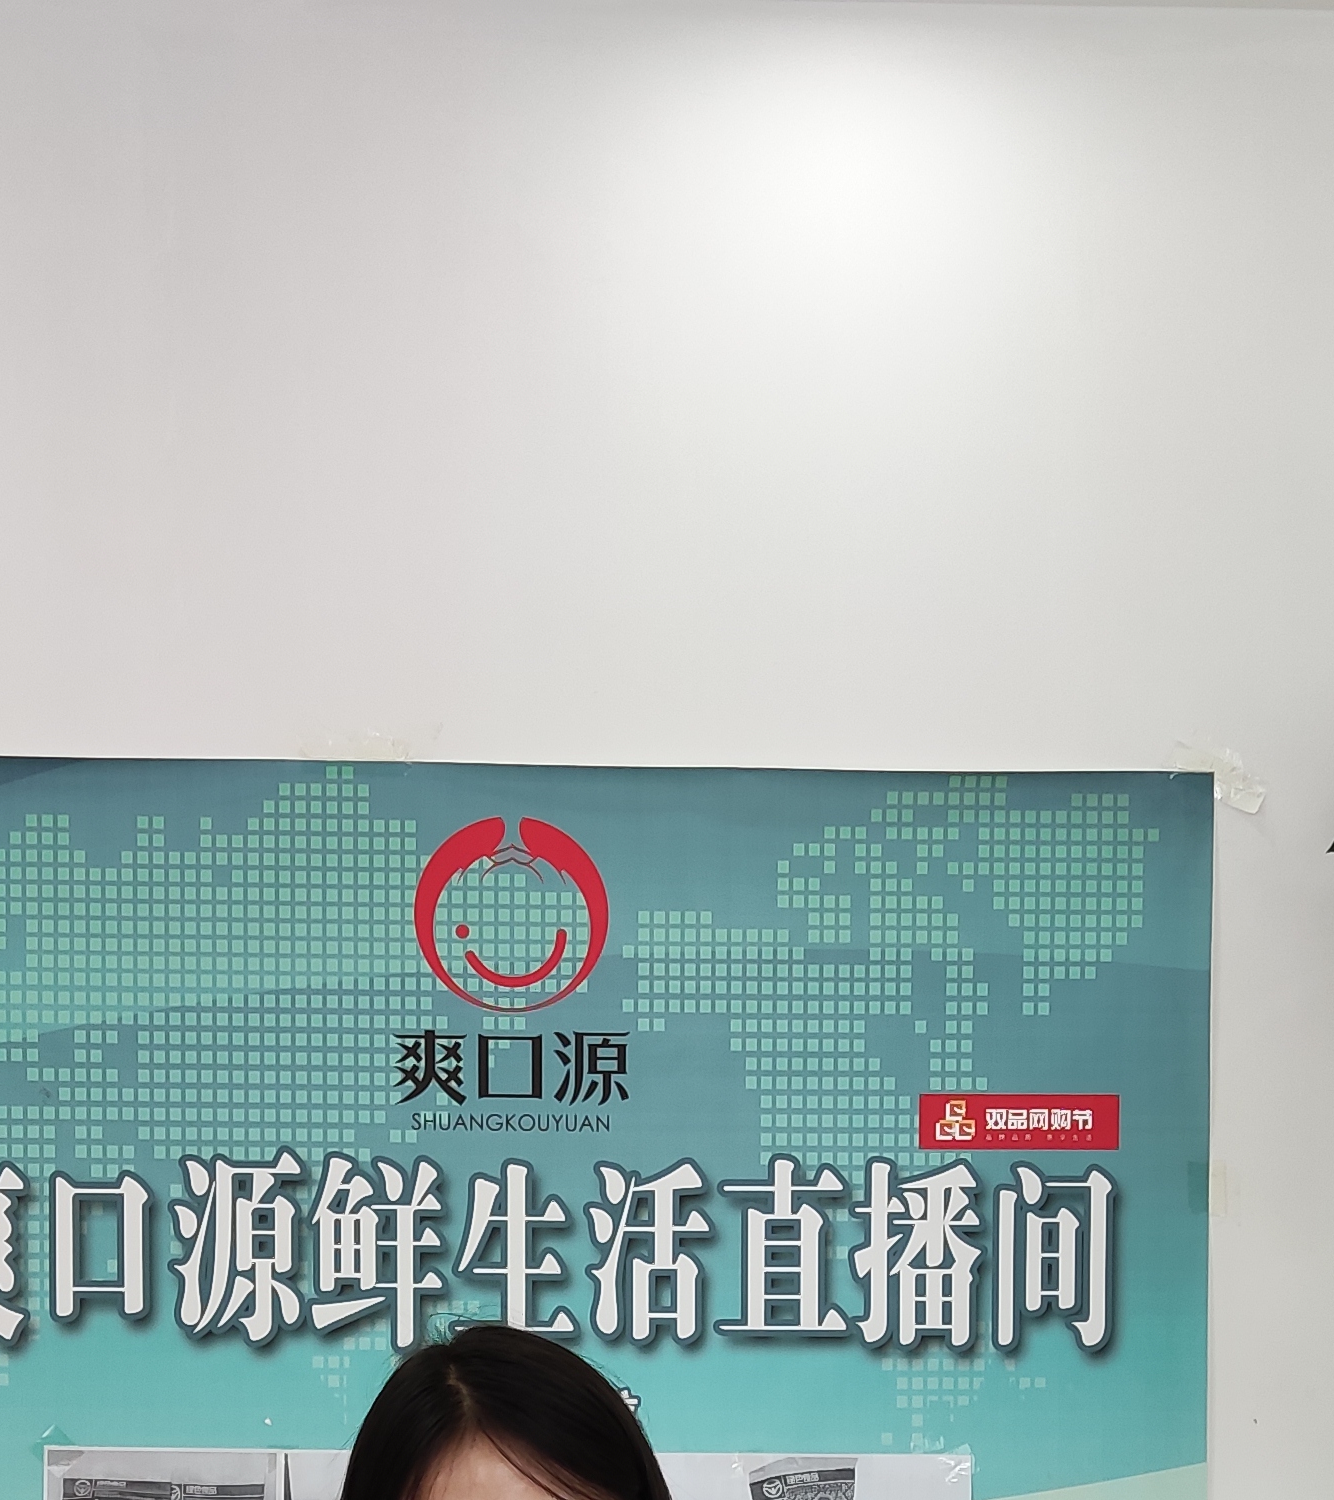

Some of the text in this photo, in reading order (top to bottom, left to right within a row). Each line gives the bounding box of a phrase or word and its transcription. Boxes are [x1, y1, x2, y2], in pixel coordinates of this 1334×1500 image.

[392, 1029, 630, 1106] 爽口源
[411, 1112, 611, 1132] SHUANGKOUYUAN
[985, 1108, 1093, 1130] 双品网购节
